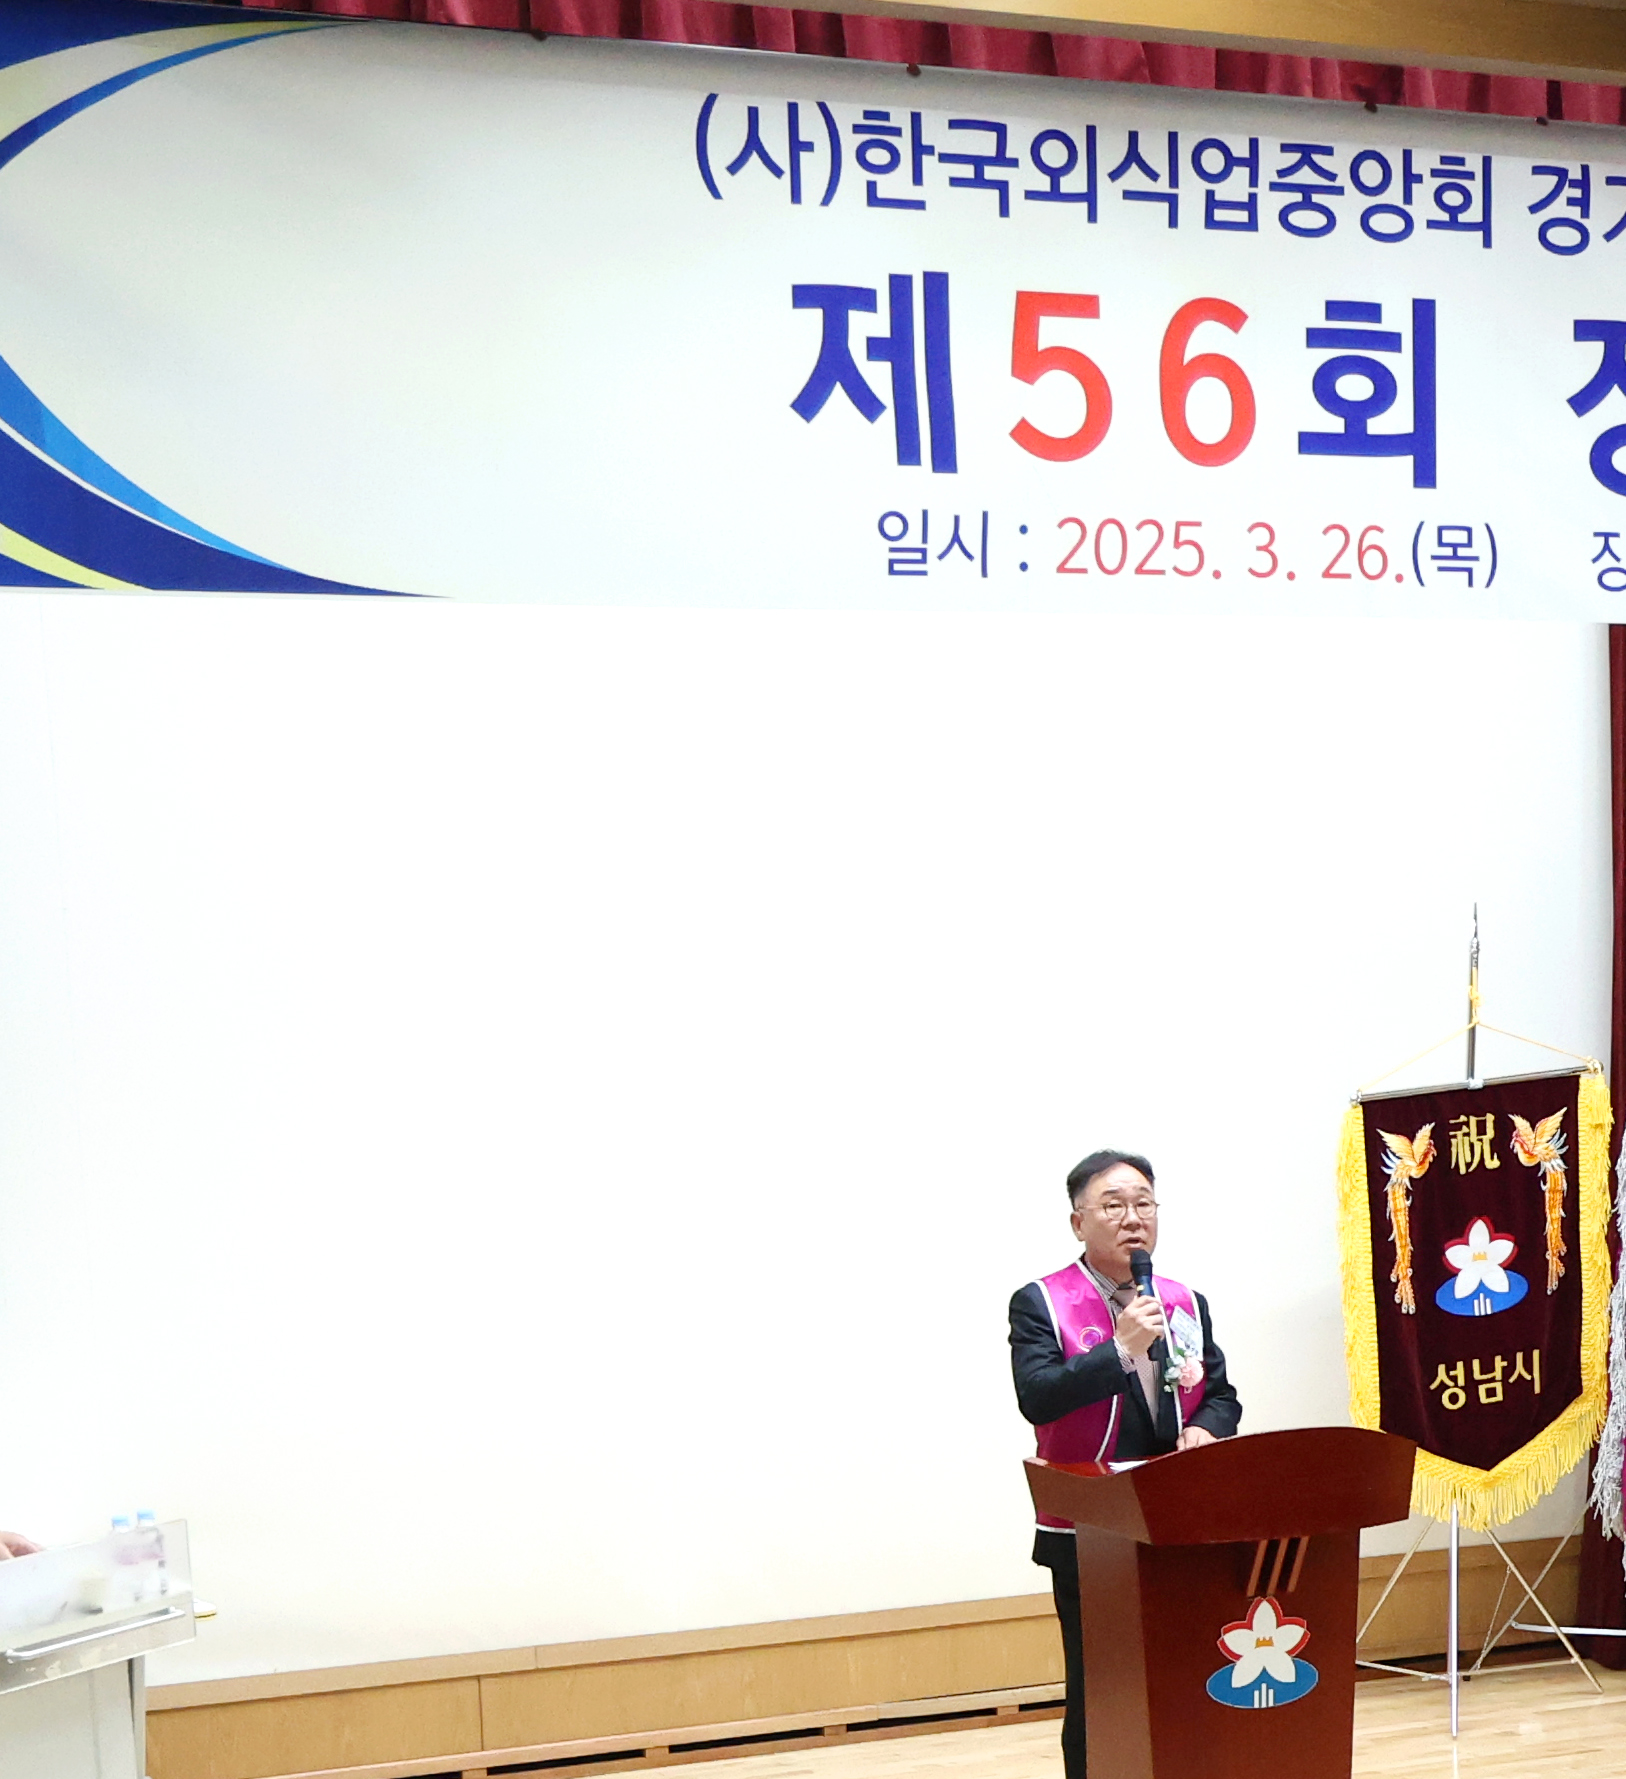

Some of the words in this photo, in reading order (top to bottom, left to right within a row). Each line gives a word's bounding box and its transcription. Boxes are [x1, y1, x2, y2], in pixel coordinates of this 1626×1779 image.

[695, 93, 1493, 249] (사)한국외식업중앙회
[877, 508, 990, 578] 일시
[1448, 1112, 1500, 1176] 祝
[1429, 1349, 1542, 1411] 성남시
